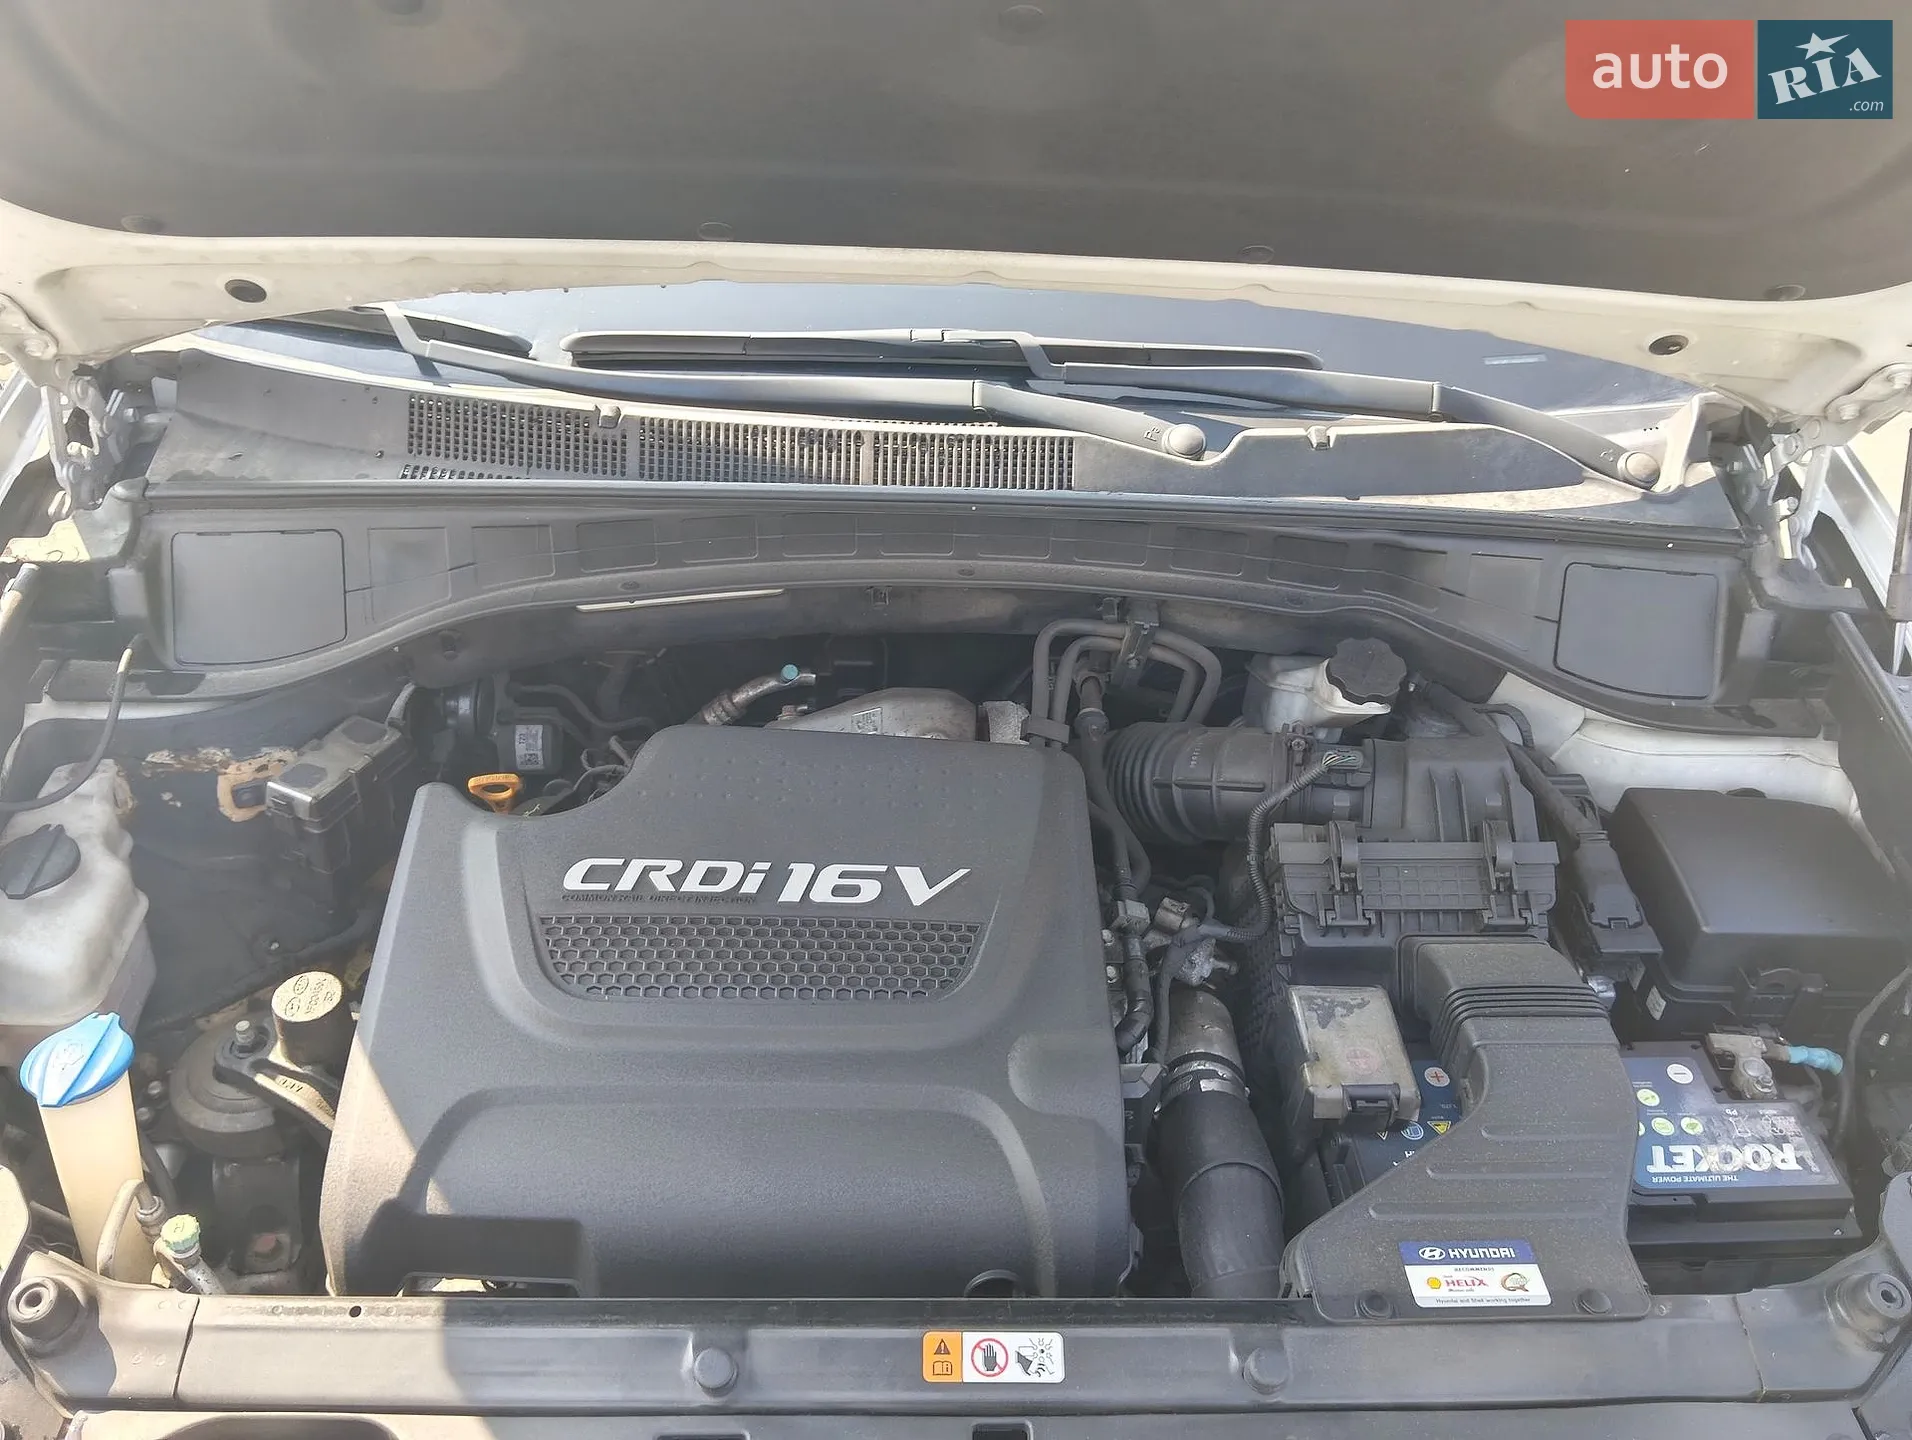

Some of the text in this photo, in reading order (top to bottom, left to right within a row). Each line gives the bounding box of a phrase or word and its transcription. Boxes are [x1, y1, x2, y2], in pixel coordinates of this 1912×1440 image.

[562, 857, 772, 895] CRDi
[1646, 1142, 1803, 1174] ROCKET
[1684, 1175, 1722, 1183] ULTIMATE
[1448, 1247, 1516, 1259] HYUNDAI
[1445, 1278, 1489, 1287] HELIX
